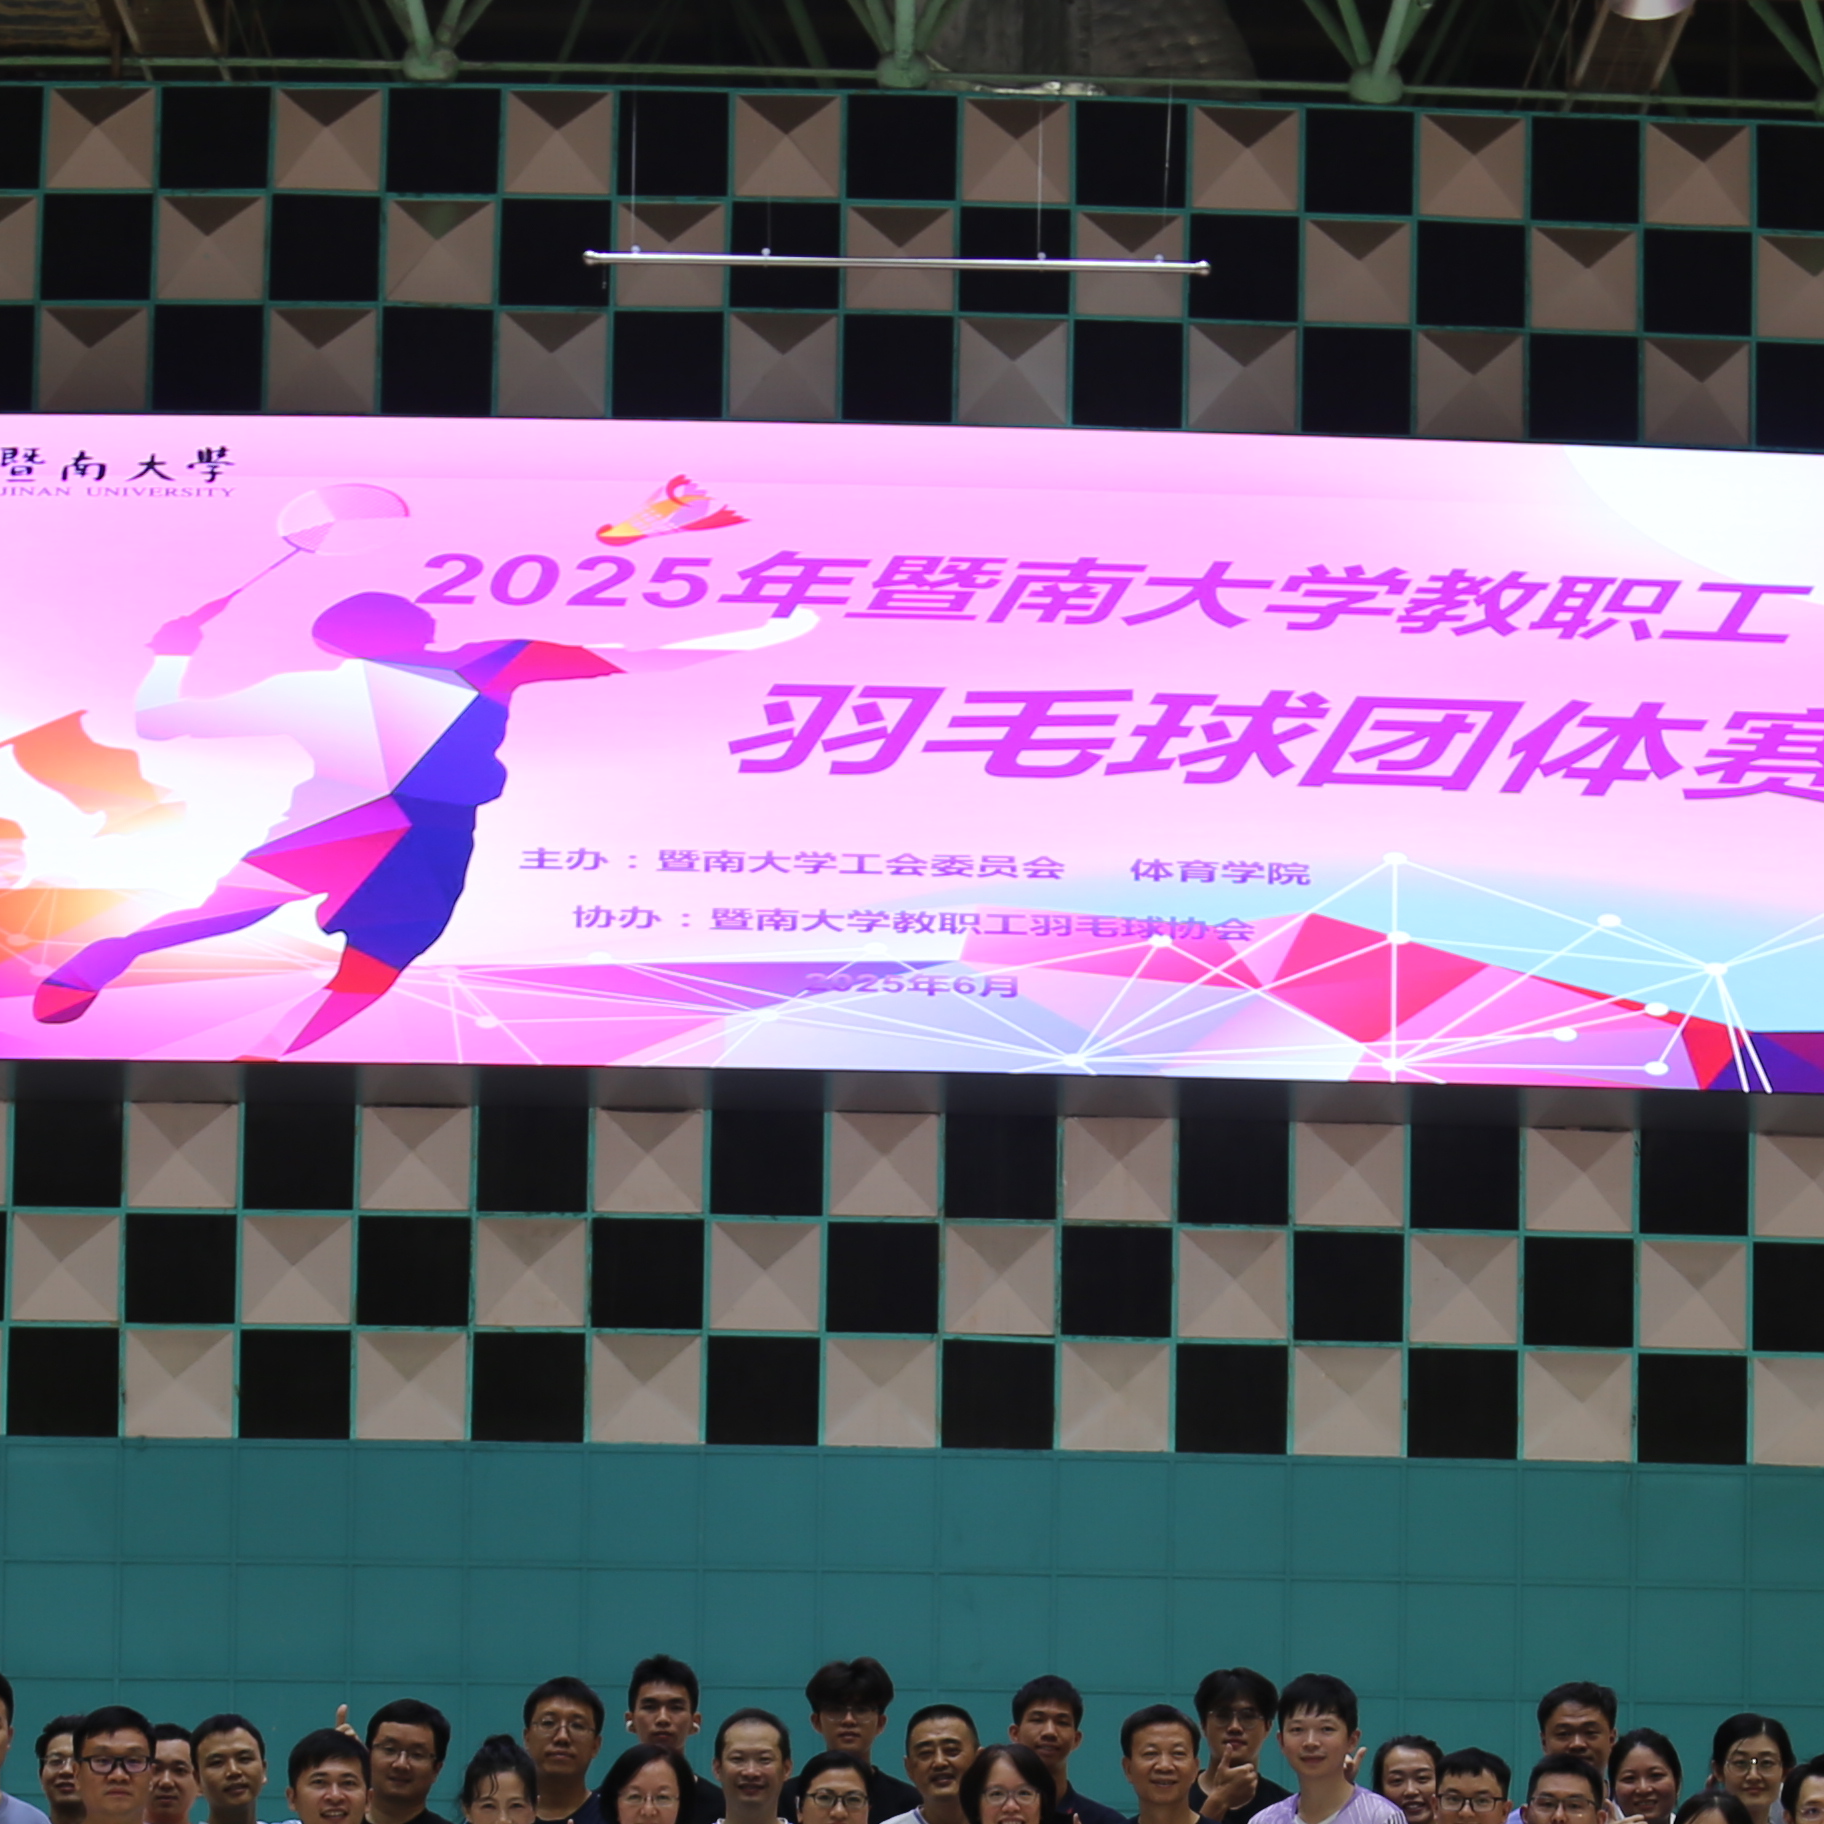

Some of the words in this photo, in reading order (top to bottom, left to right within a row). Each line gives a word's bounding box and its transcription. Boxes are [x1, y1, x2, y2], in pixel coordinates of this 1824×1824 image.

[0, 445, 236, 482] 暨南大學
[0, 486, 71, 498] JINAN
[87, 487, 236, 499] UNIVERSITY
[414, 549, 1815, 644] 2025年暨南大学教职工
[1130, 857, 1312, 886] 体育学院
